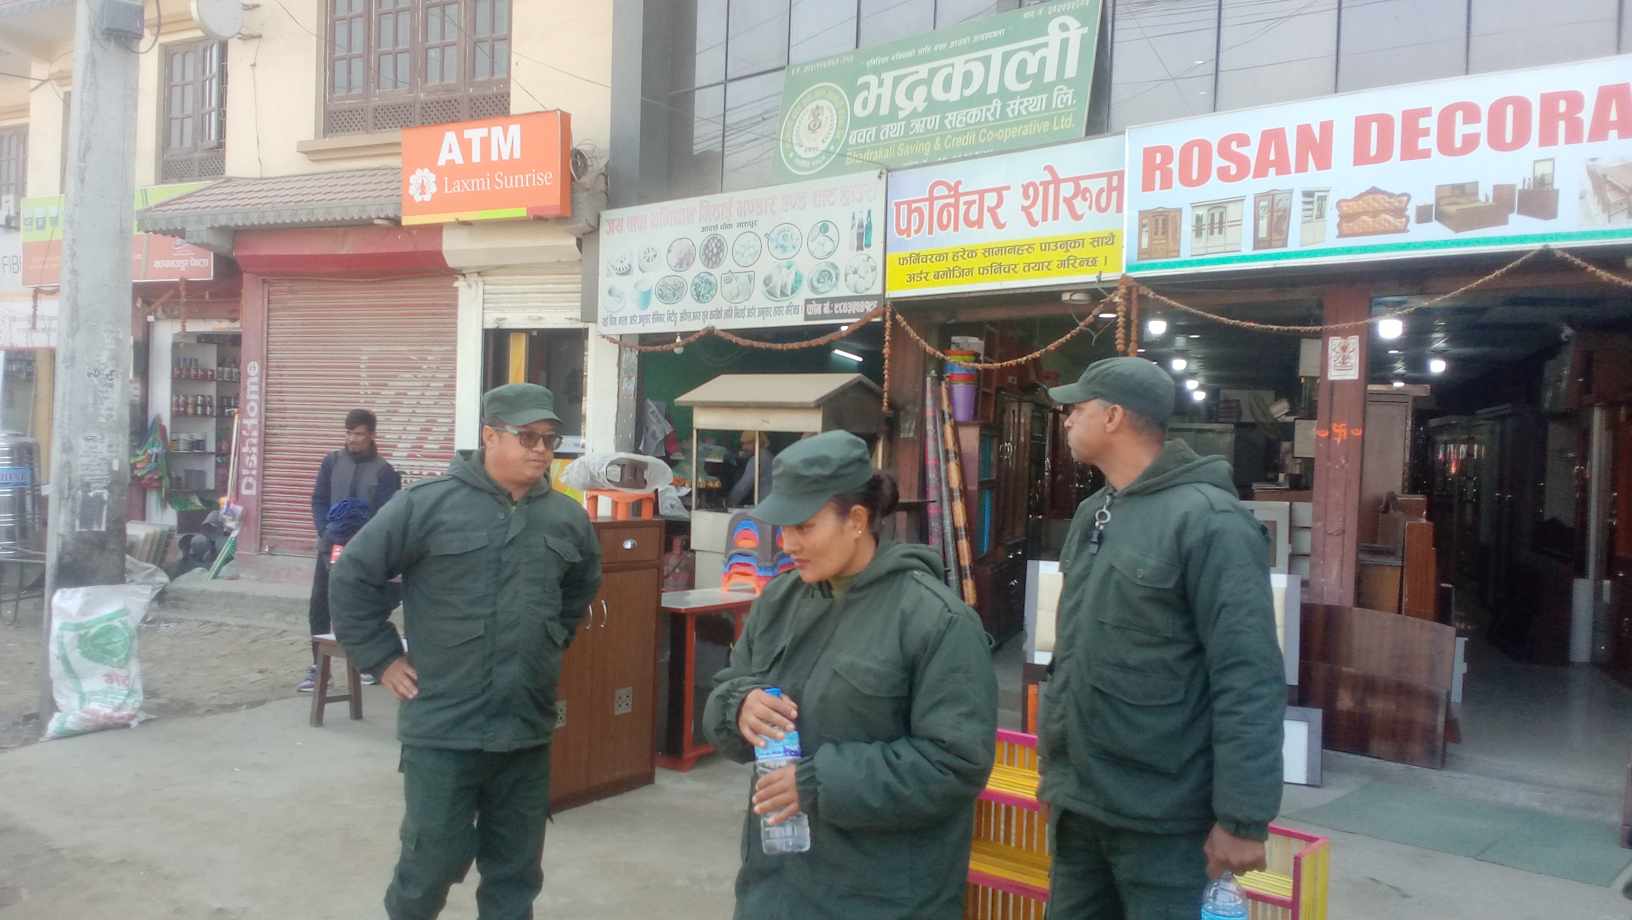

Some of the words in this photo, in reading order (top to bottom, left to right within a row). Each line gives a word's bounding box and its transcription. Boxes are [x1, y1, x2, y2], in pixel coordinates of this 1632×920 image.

[853, 15, 1088, 119] भद्रकाली
[880, 121, 907, 141] तथा
[944, 98, 1001, 129] सहकारी
[1007, 95, 1048, 118] संस्था
[1052, 85, 1077, 109] लि.
[896, 140, 931, 157] Saving
[933, 134, 943, 150] &
[944, 127, 977, 150] Credit
[978, 118, 1050, 144] Co-operative
[1053, 110, 1077, 131] Ltd.
[437, 124, 521, 166] ATM
[1141, 119, 1334, 193] ROSAN
[1352, 82, 1632, 167] DECORA
[444, 173, 490, 193] Laxmi
[495, 169, 553, 190] Sunrise
[894, 180, 1011, 240] फर्निचर
[933, 265, 974, 281] बमोजिम
[978, 261, 1020, 276] फर्निचर
[1023, 259, 1052, 273] तयार
[951, 247, 977, 261] हरेक
